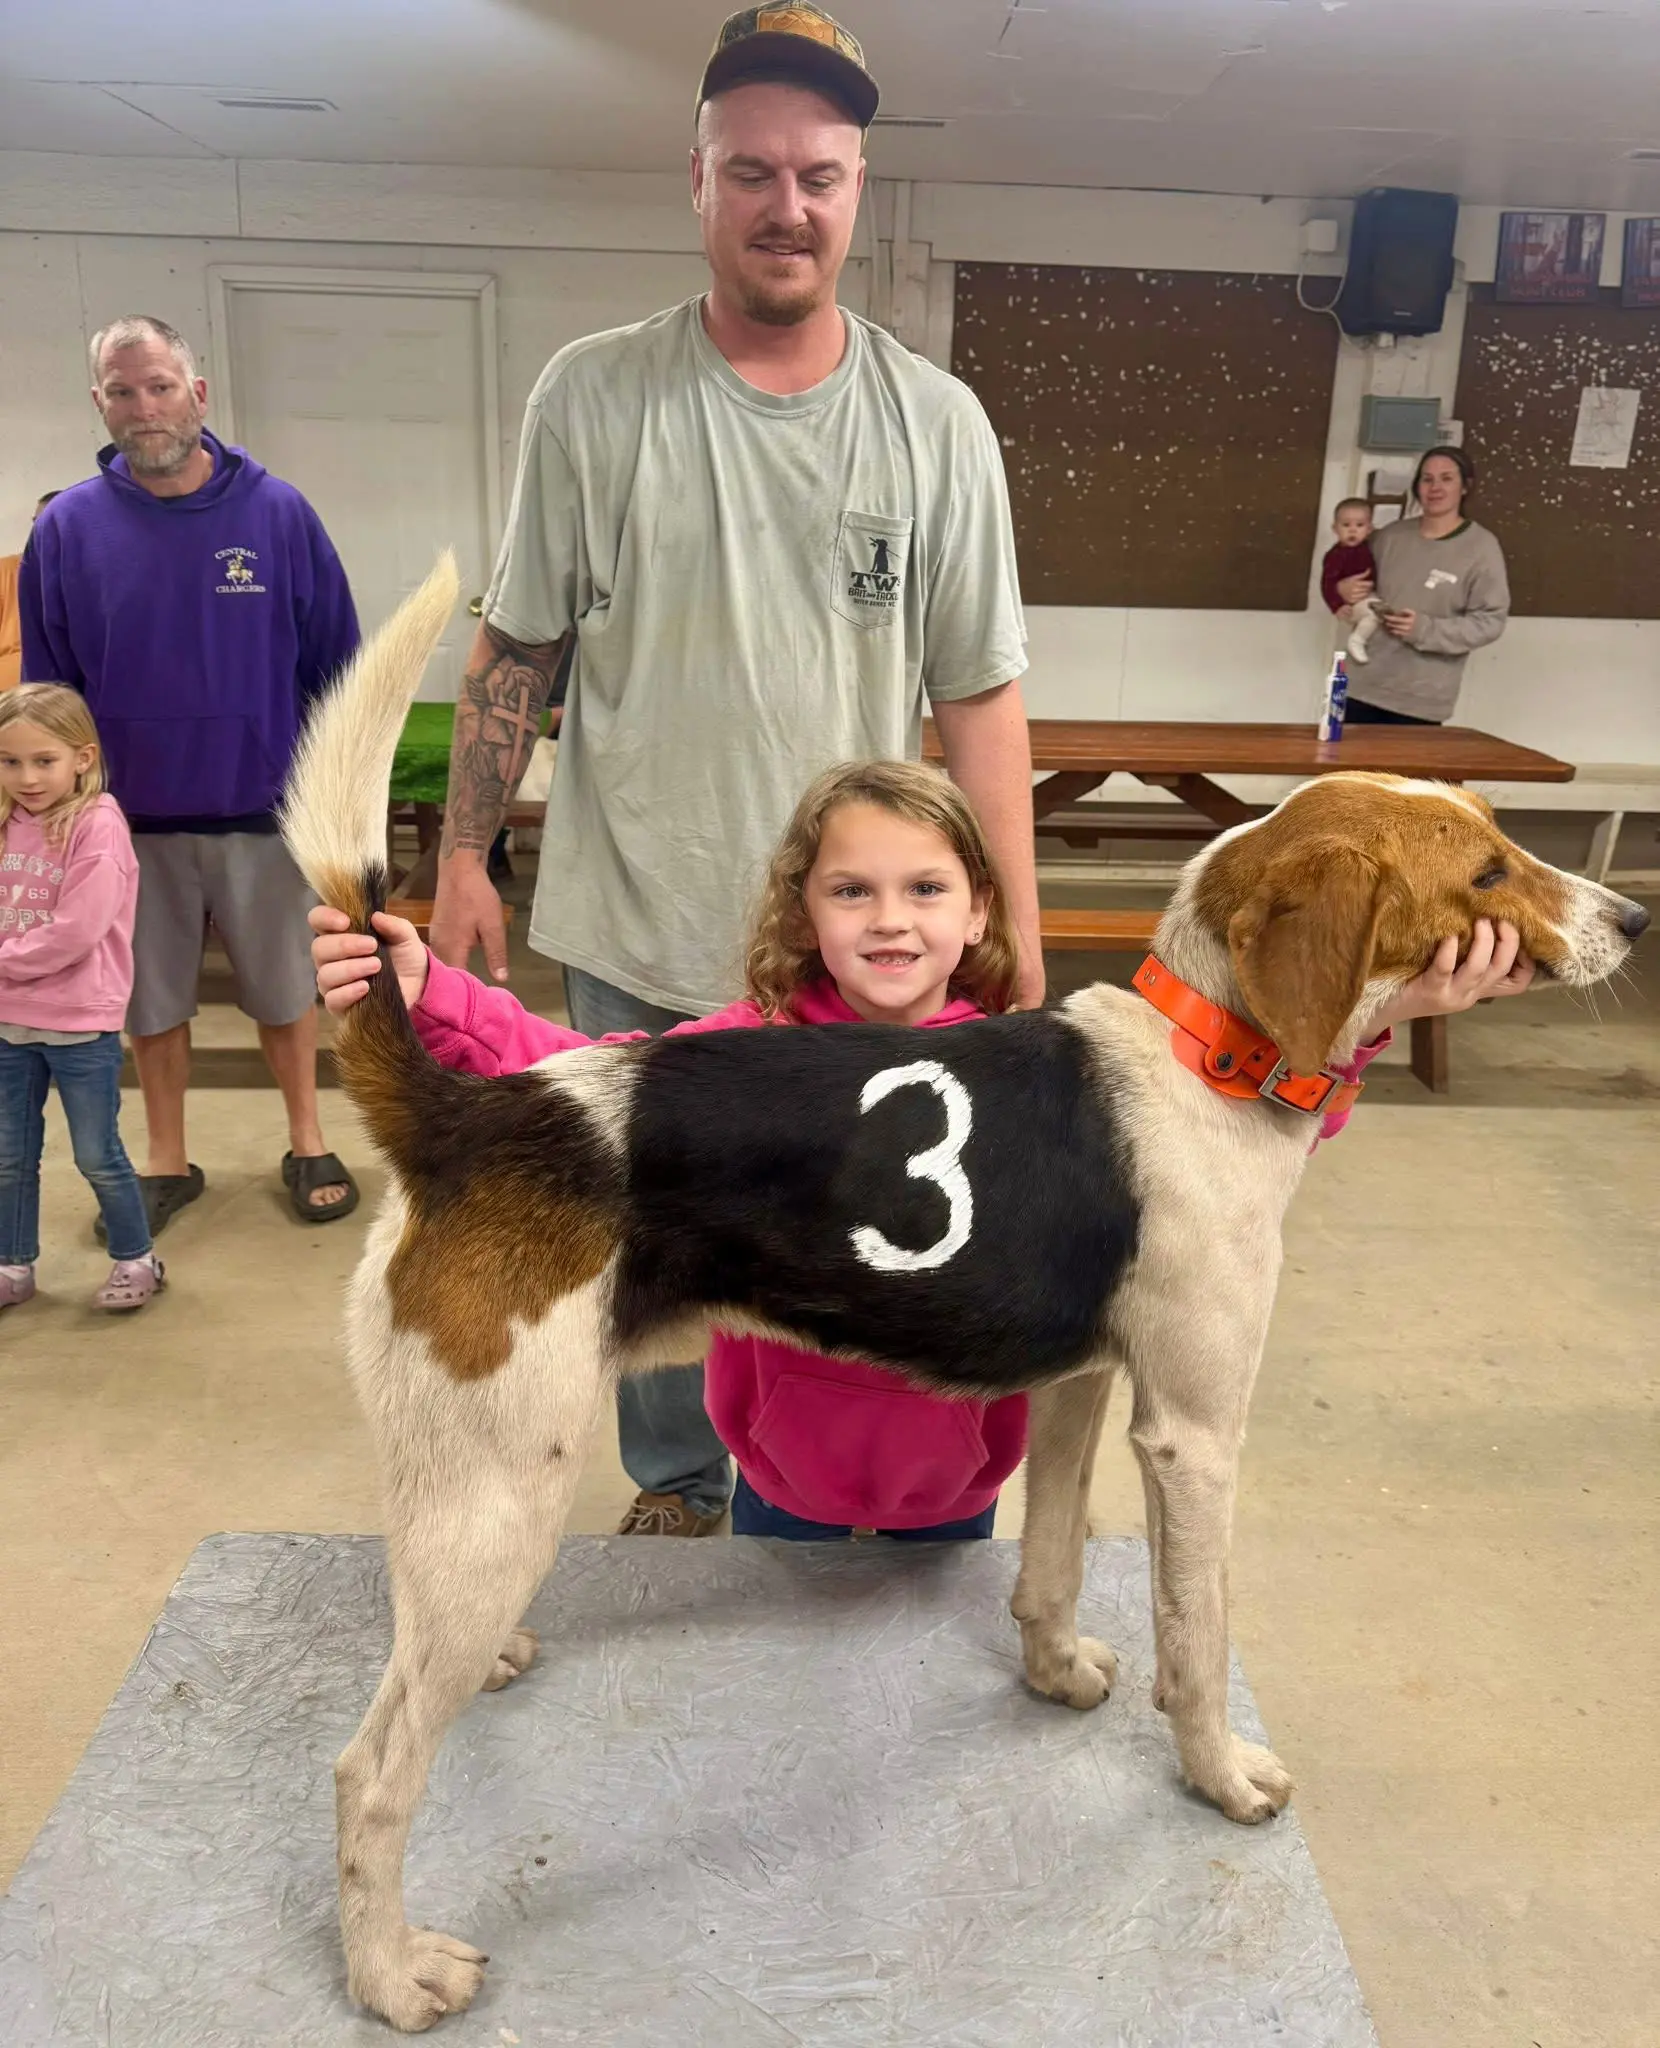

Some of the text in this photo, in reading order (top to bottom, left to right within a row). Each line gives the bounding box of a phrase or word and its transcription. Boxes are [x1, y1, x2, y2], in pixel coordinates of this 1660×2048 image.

[214, 547, 259, 560] CENTRAL
[215, 584, 266, 593] CHARGERS
[848, 587, 867, 598] BAIT
[0, 853, 64, 885] WAYS
[27, 887, 49, 900] 69
[848, 1059, 974, 1272] 3
